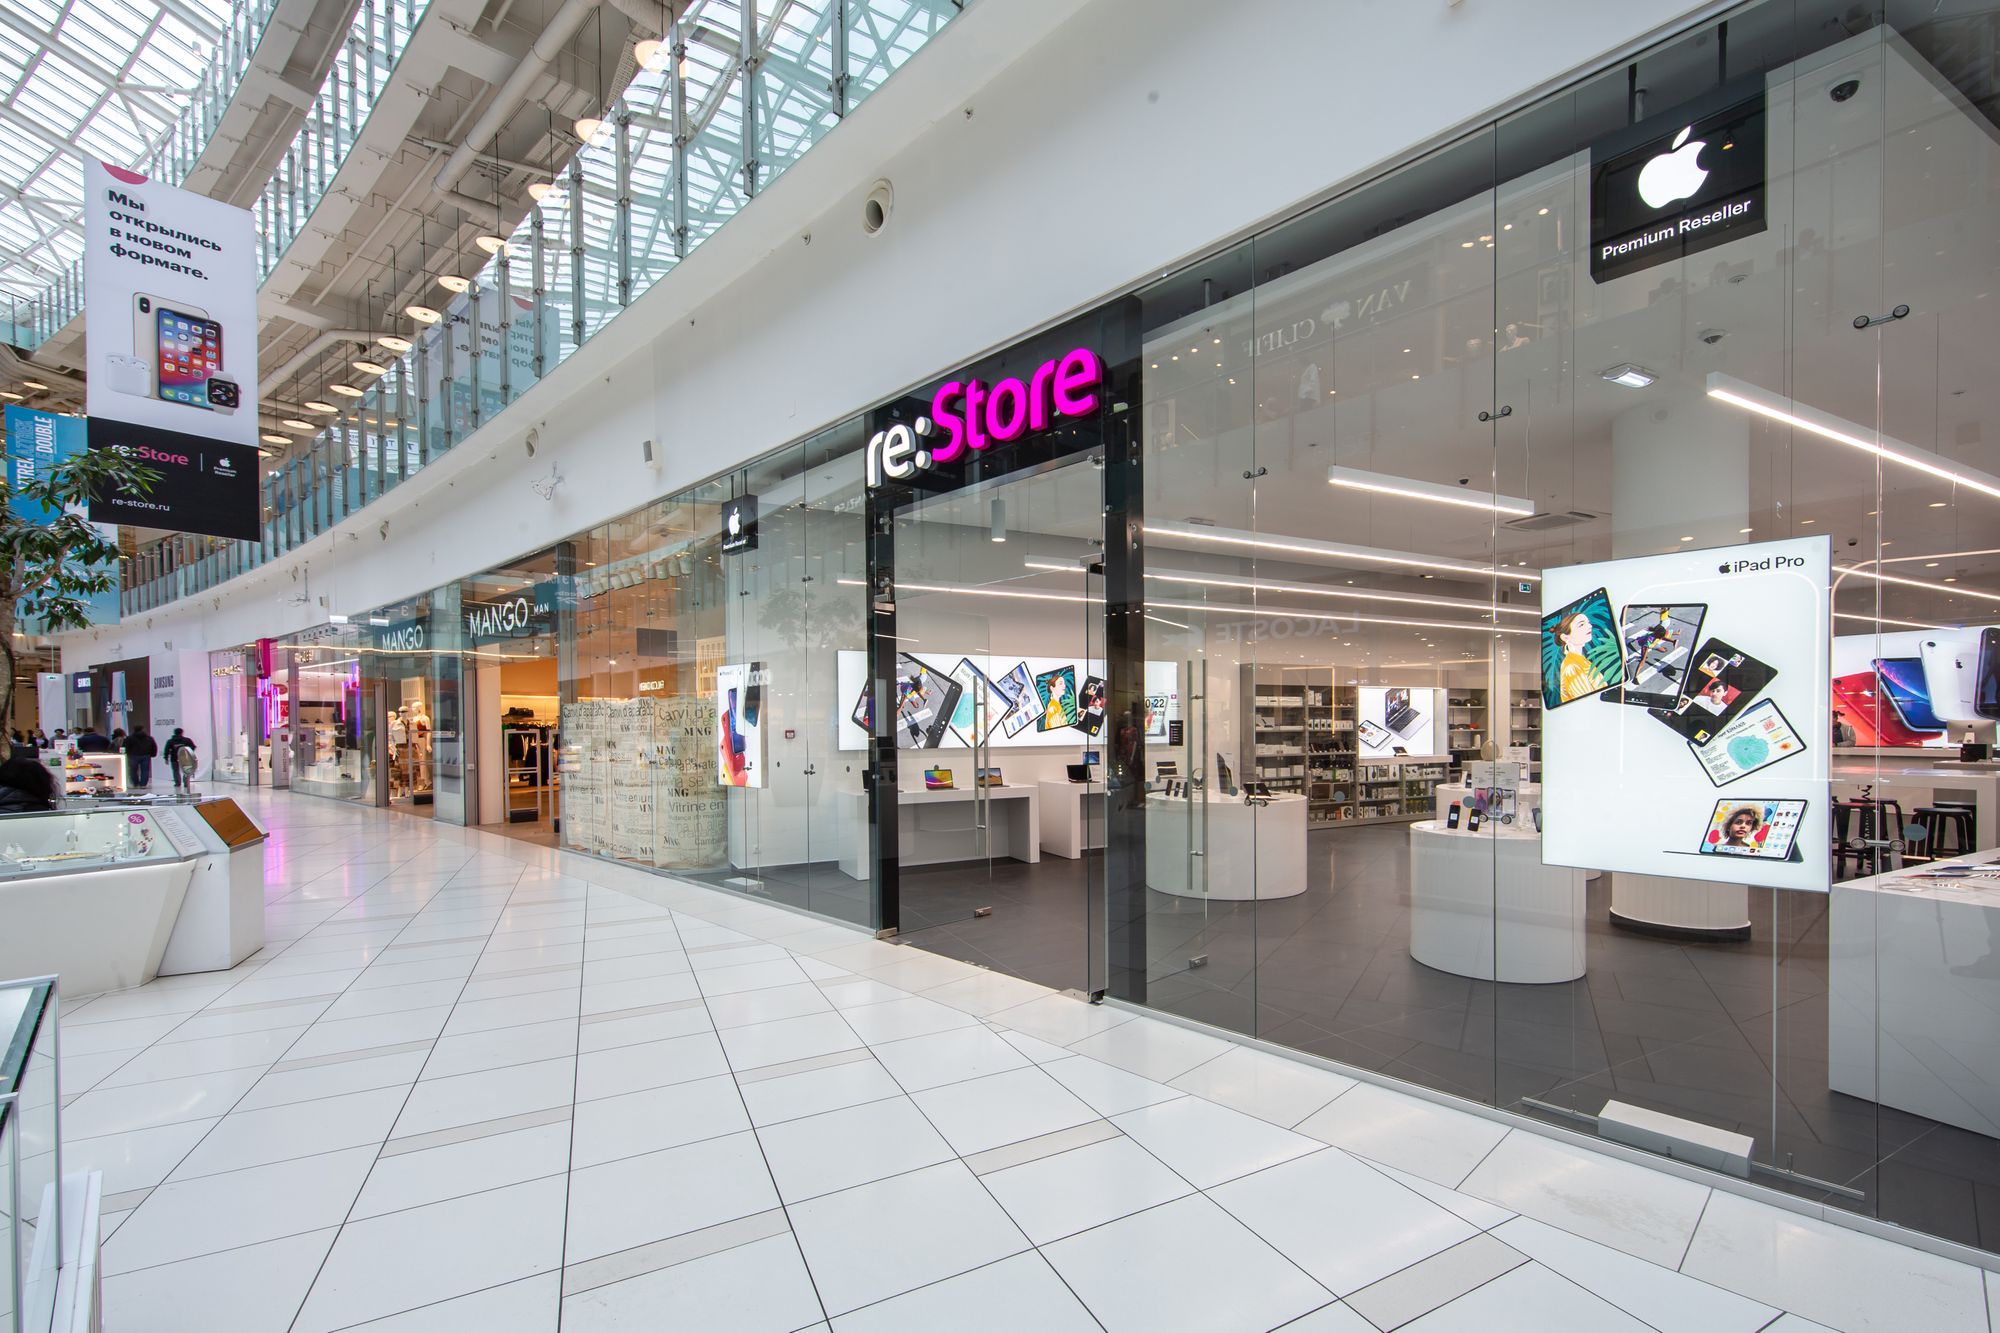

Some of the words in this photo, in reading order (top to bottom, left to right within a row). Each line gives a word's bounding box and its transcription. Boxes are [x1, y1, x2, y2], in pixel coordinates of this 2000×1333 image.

[108, 190, 145, 212] Мы
[109, 210, 222, 252] открылись
[1602, 225, 1675, 260] Premium
[1679, 200, 1752, 234] Reseller
[109, 227, 122, 238] в
[126, 232, 192, 259] новом
[109, 243, 209, 280] формате.
[867, 347, 1103, 488] re:Store
[34, 415, 54, 454] DOUBLE
[111, 443, 189, 466] re:Store
[111, 497, 170, 512] re-store.ru
[1733, 558, 1770, 574] iPad
[1775, 555, 1805, 569] Pro
[469, 597, 528, 639] MANGO
[533, 602, 549, 616] MAN
[382, 624, 424, 651] MANGO
[153, 674, 174, 690] SAMSUNG
[684, 727, 712, 737] MNG
[667, 788, 689, 798] MNG
[668, 801, 706, 813] Vitrine
[709, 801, 724, 811] en
